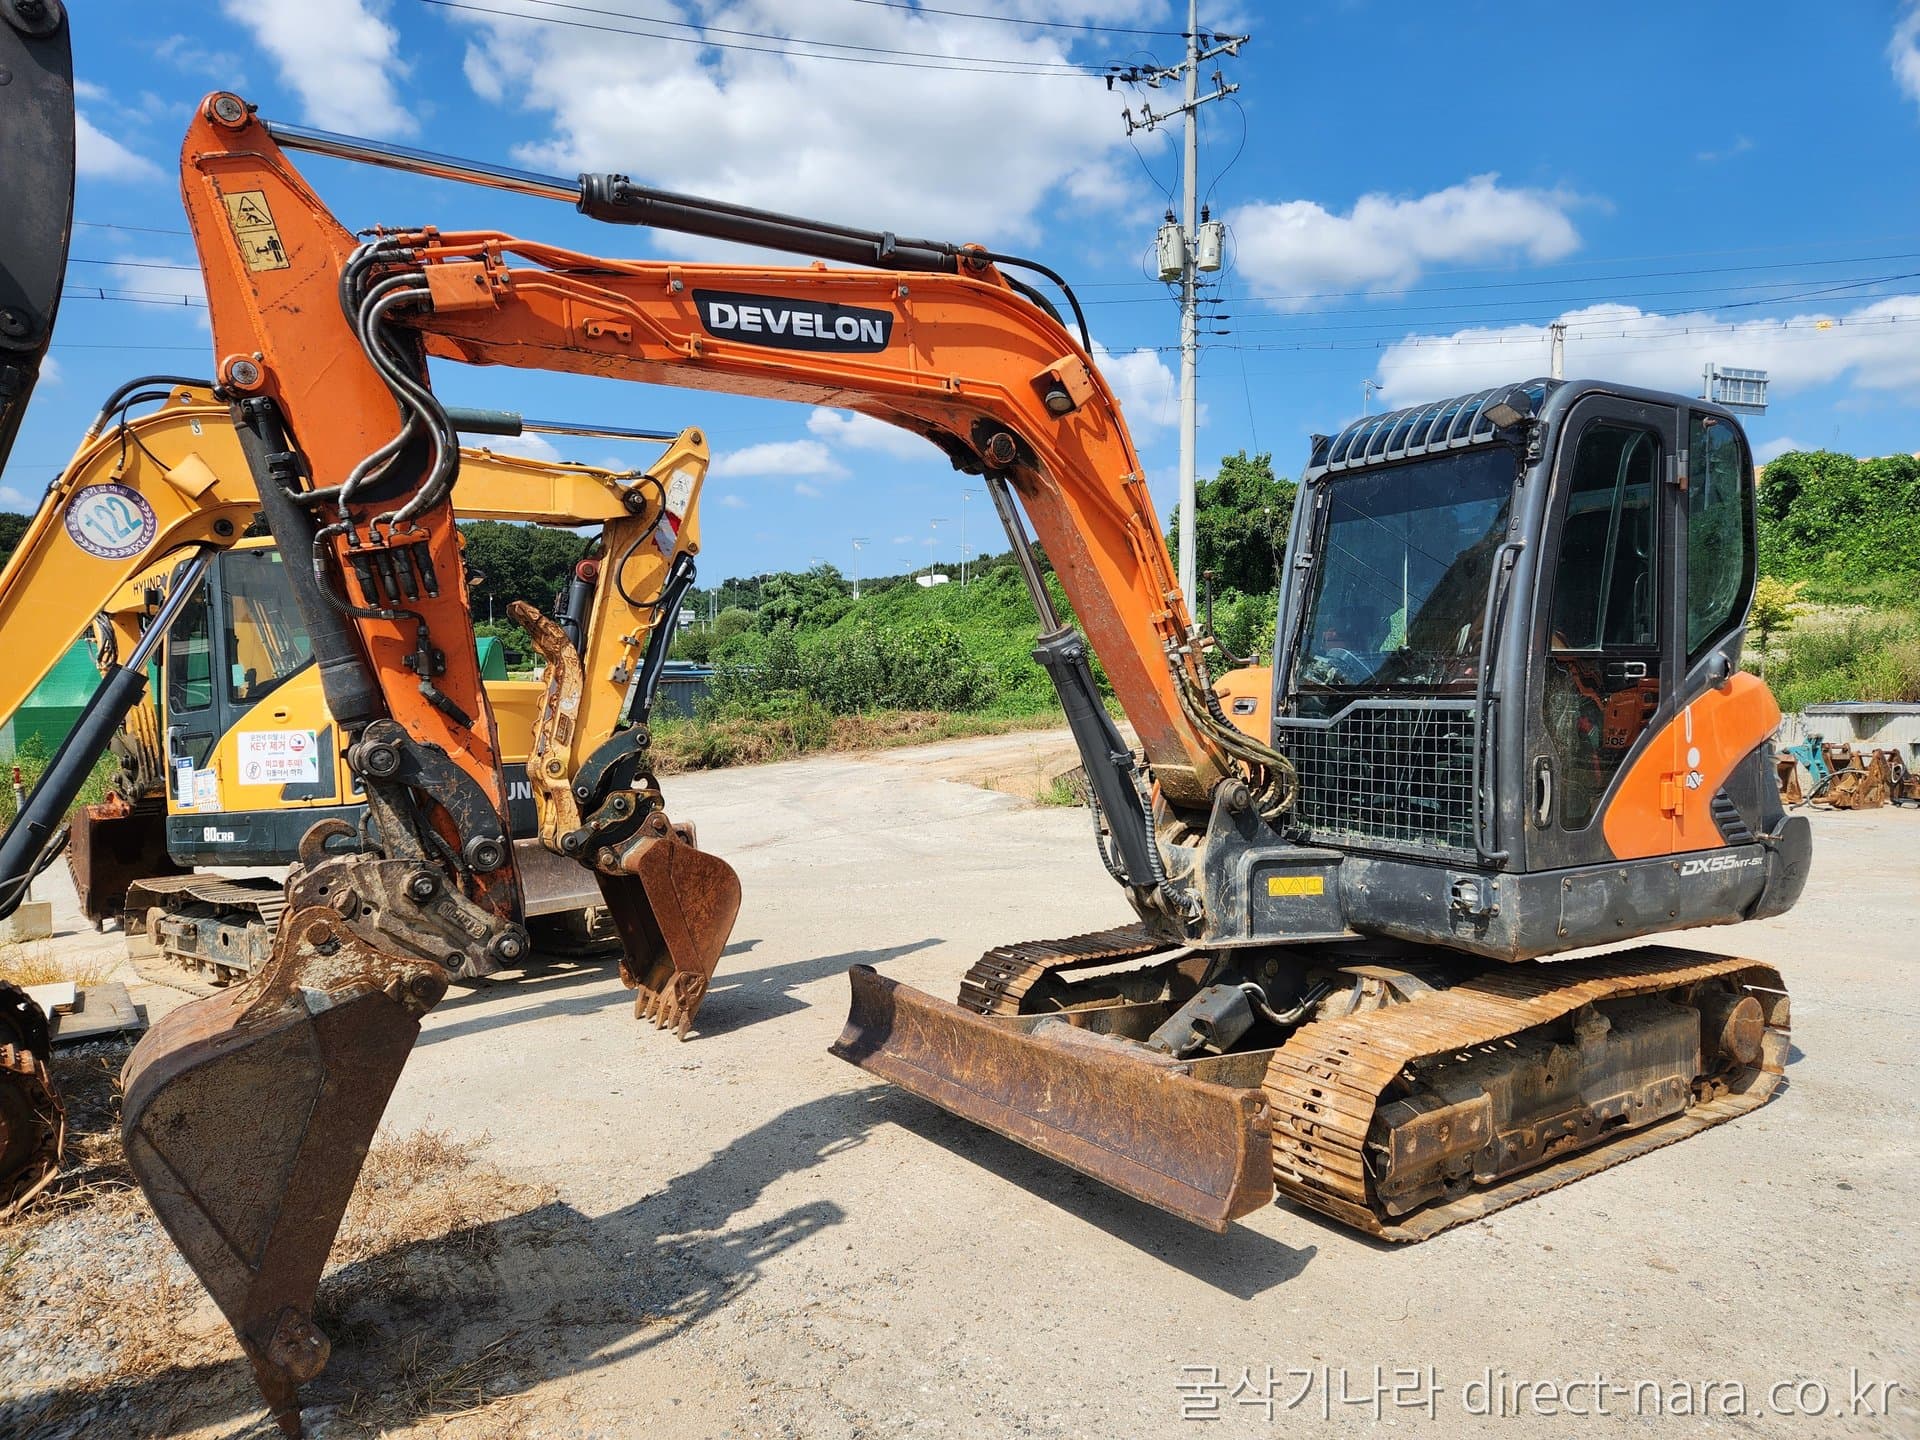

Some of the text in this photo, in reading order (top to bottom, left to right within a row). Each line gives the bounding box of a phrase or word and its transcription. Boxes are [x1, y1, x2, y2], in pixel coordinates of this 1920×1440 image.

[708, 302, 884, 344] DEVELON
[85, 496, 143, 544] 122
[133, 570, 170, 596] HYUND
[250, 741, 286, 751] KEY 제거
